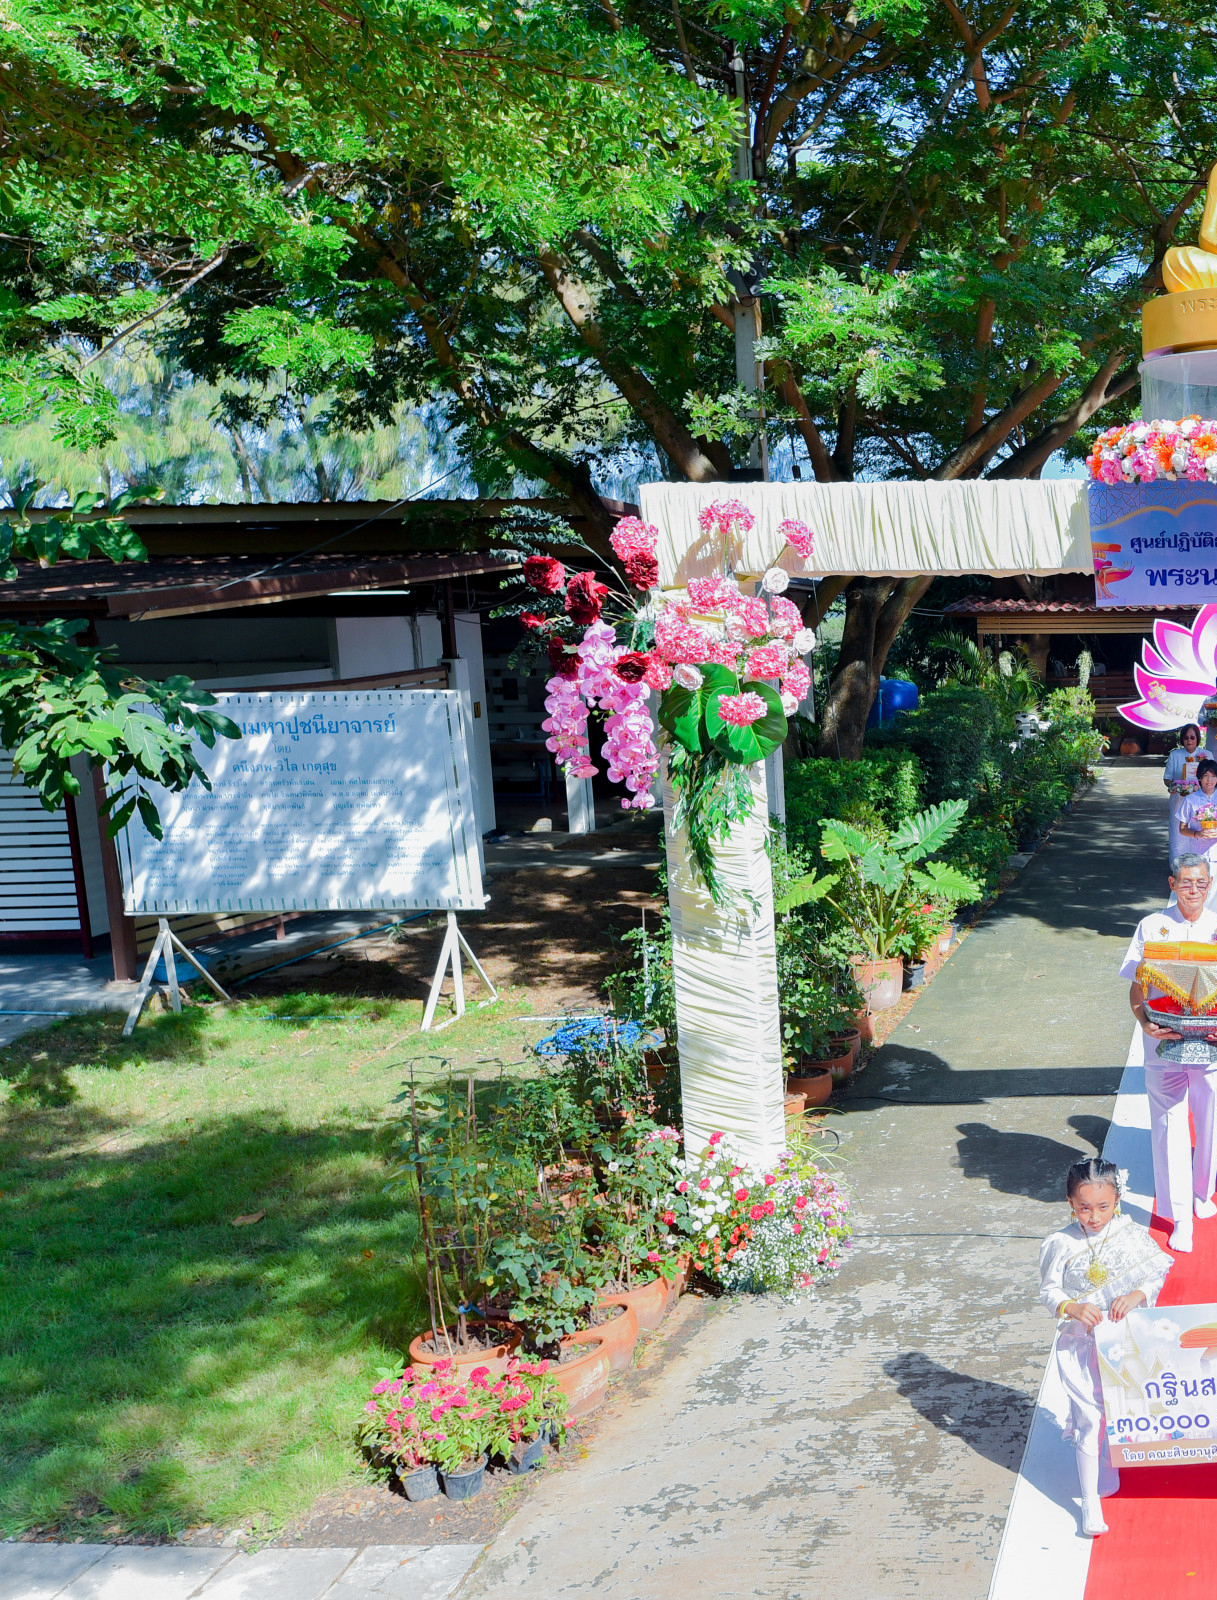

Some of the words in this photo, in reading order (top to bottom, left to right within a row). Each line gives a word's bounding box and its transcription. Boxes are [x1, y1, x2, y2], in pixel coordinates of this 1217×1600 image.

[272, 740, 291, 753] โดย
[302, 761, 337, 775] เกตุสุข
[1116, 1413, 1210, 1434] ๓๐,๐๐๐
[1122, 1449, 1145, 1462] โดย
